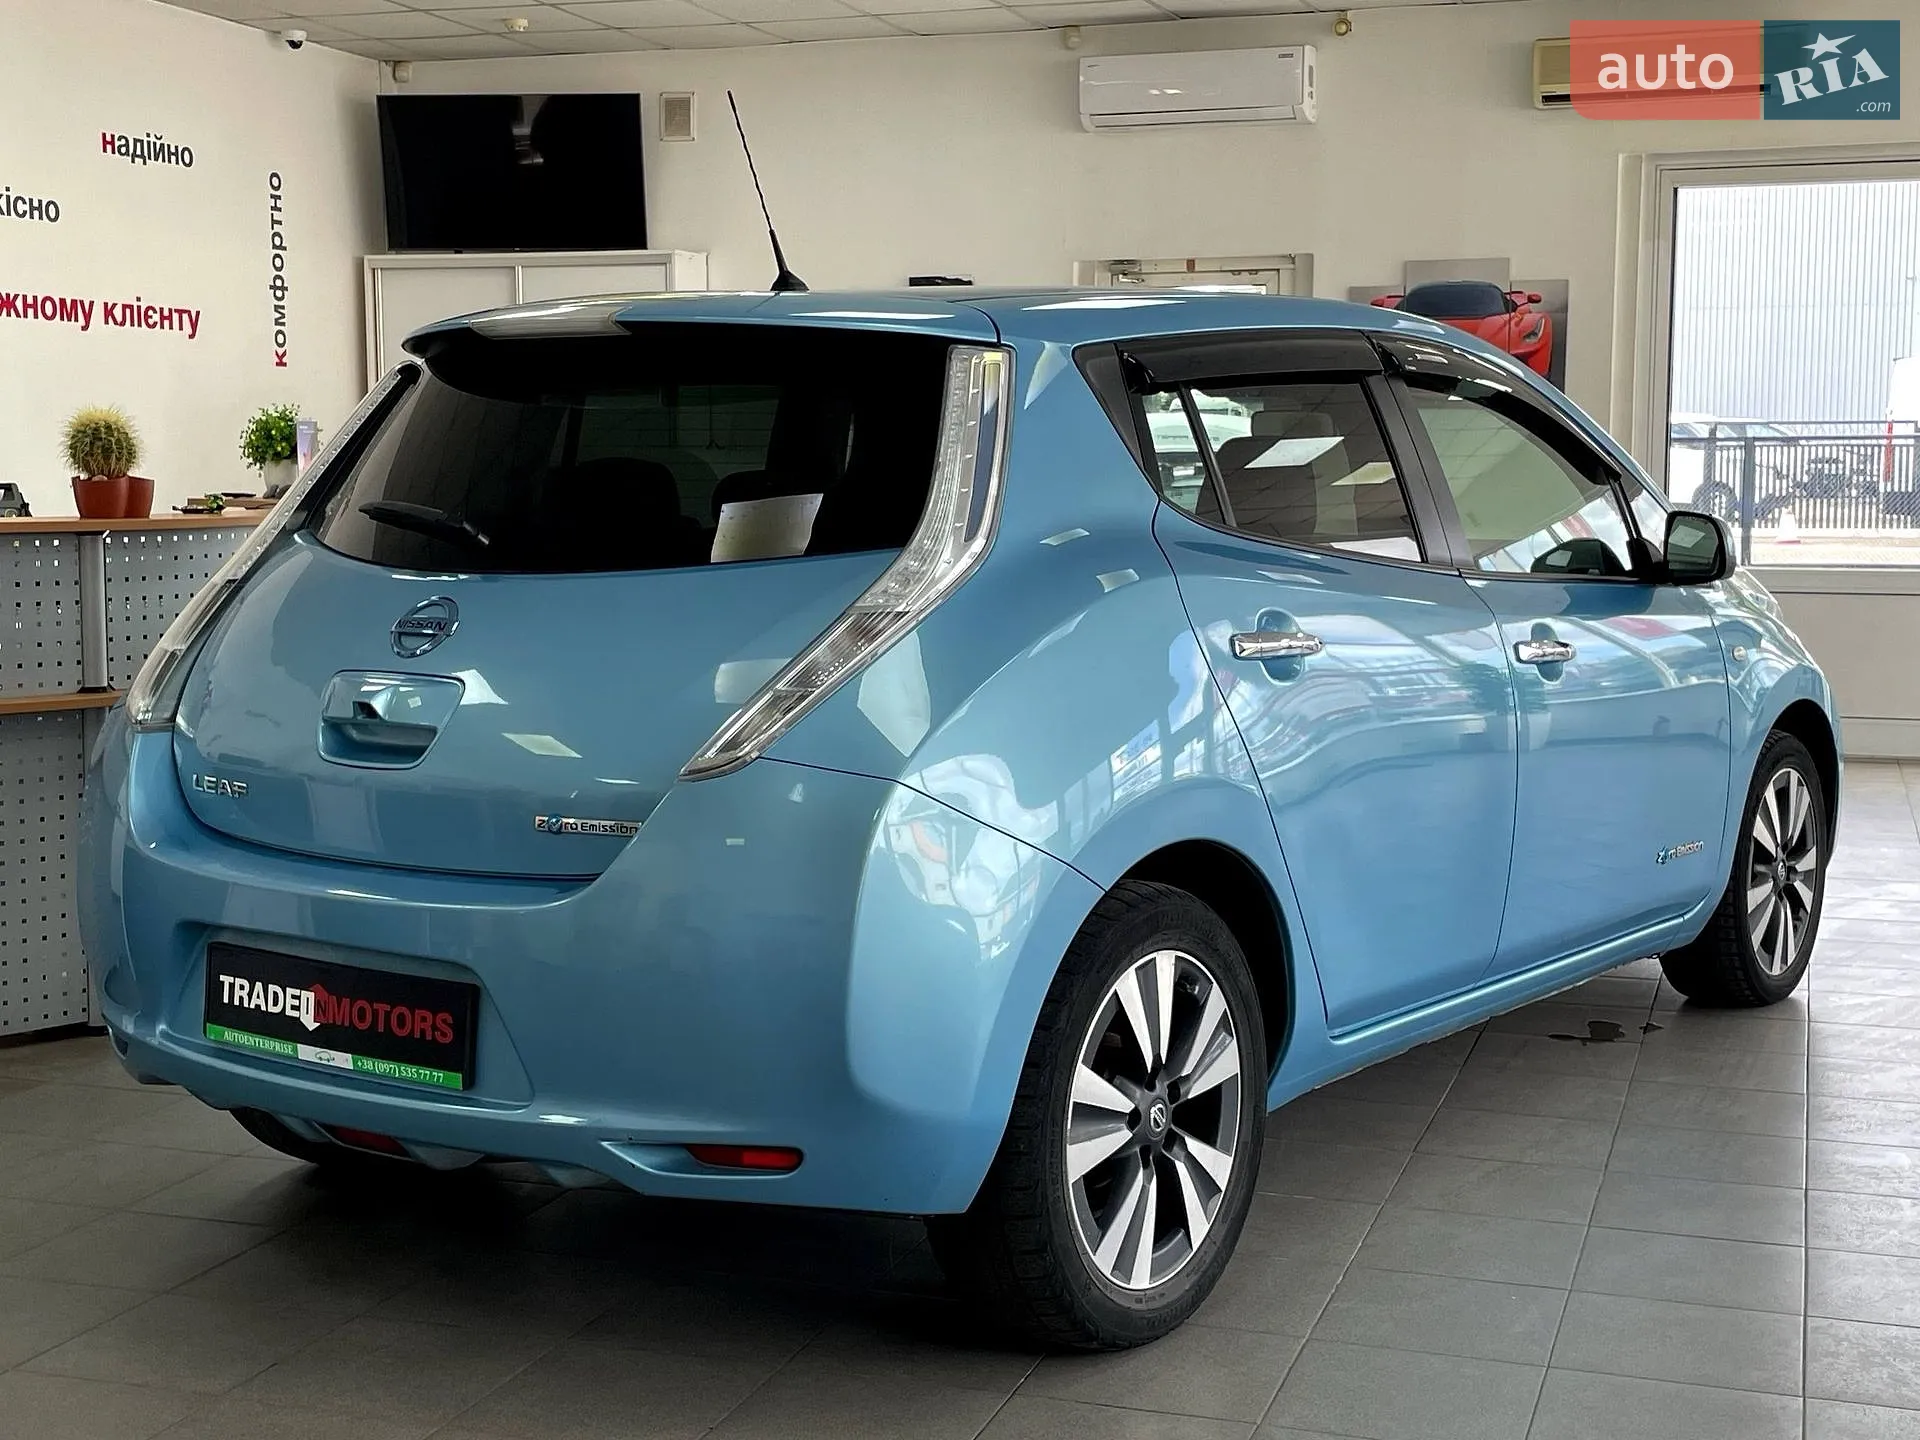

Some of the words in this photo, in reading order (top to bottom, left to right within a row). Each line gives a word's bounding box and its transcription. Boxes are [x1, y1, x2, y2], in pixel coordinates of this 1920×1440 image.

[102, 131, 194, 168] надійно
[269, 171, 289, 367] комфортно
[103, 296, 200, 339] клієнту
[395, 619, 447, 632] NISSAN
[192, 774, 248, 799] LEAF
[580, 820, 639, 835] Emission
[219, 974, 301, 1018] TRADE
[328, 995, 454, 1044] MOTORS
[222, 1030, 295, 1055] AUTOENTERPRISE
[357, 1059, 373, 1071] +38
[374, 1062, 399, 1078] (097)
[400, 1066, 417, 1079] 535
[418, 1070, 430, 1081] 77
[432, 1072, 444, 1083] 77
